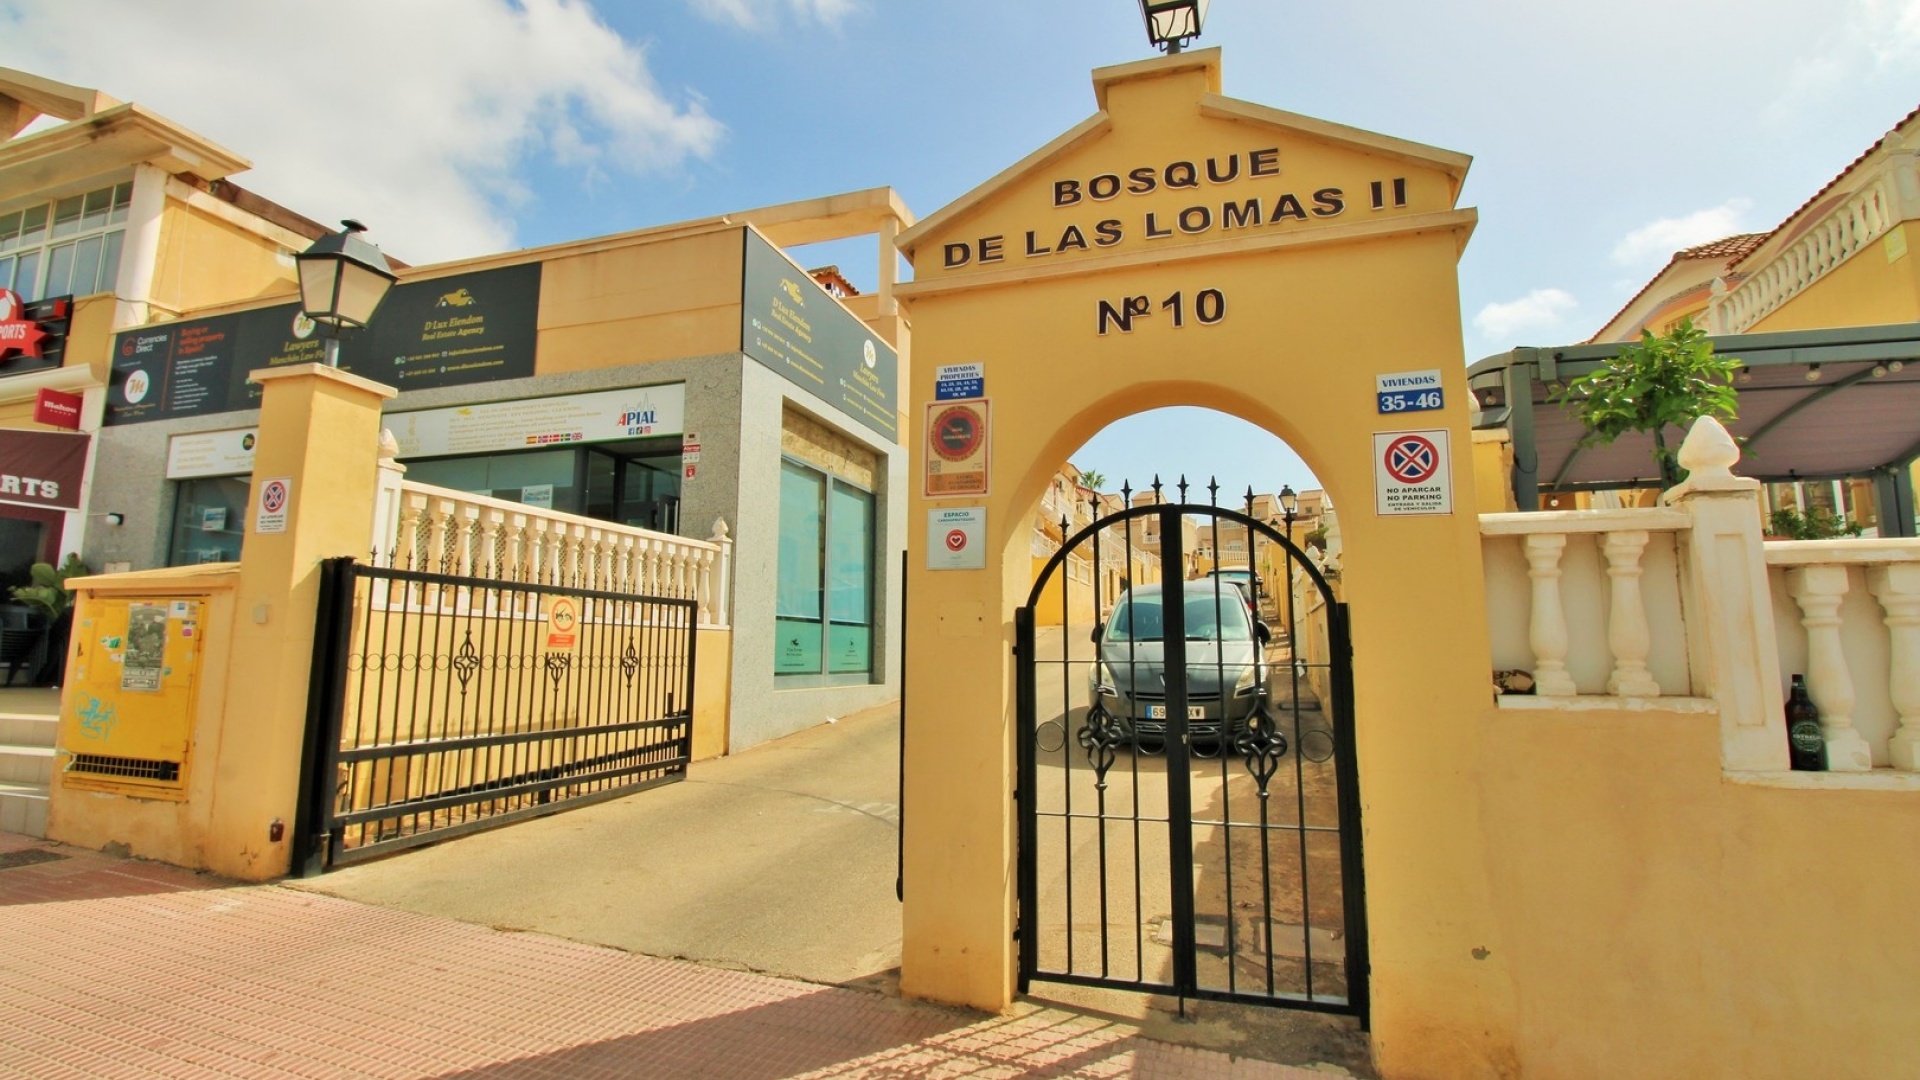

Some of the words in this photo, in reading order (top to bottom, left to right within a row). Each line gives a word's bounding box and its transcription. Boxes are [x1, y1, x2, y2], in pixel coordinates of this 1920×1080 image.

[1052, 146, 1281, 208] BOSQUE
[943, 234, 1005, 269] DE
[1025, 218, 1124, 259] LAS
[1144, 186, 1345, 241] LOMAS
[1369, 177, 1408, 210] II
[1161, 287, 1227, 328] 10
[448, 314, 484, 327] Eiendom
[136, 333, 168, 345] Currencies
[422, 332, 436, 341] Real
[436, 329, 457, 339] Estate
[457, 326, 485, 337] Agency
[135, 343, 154, 354] Direct
[284, 340, 320, 353] Lawyers
[299, 352, 314, 361] Law
[940, 372, 980, 380] PROPERTIES
[943, 365, 976, 374] VIVIENDAS
[1382, 375, 1436, 388] VIVIENDAS
[44, 400, 77, 413] Mahou
[617, 410, 658, 426] APIAL
